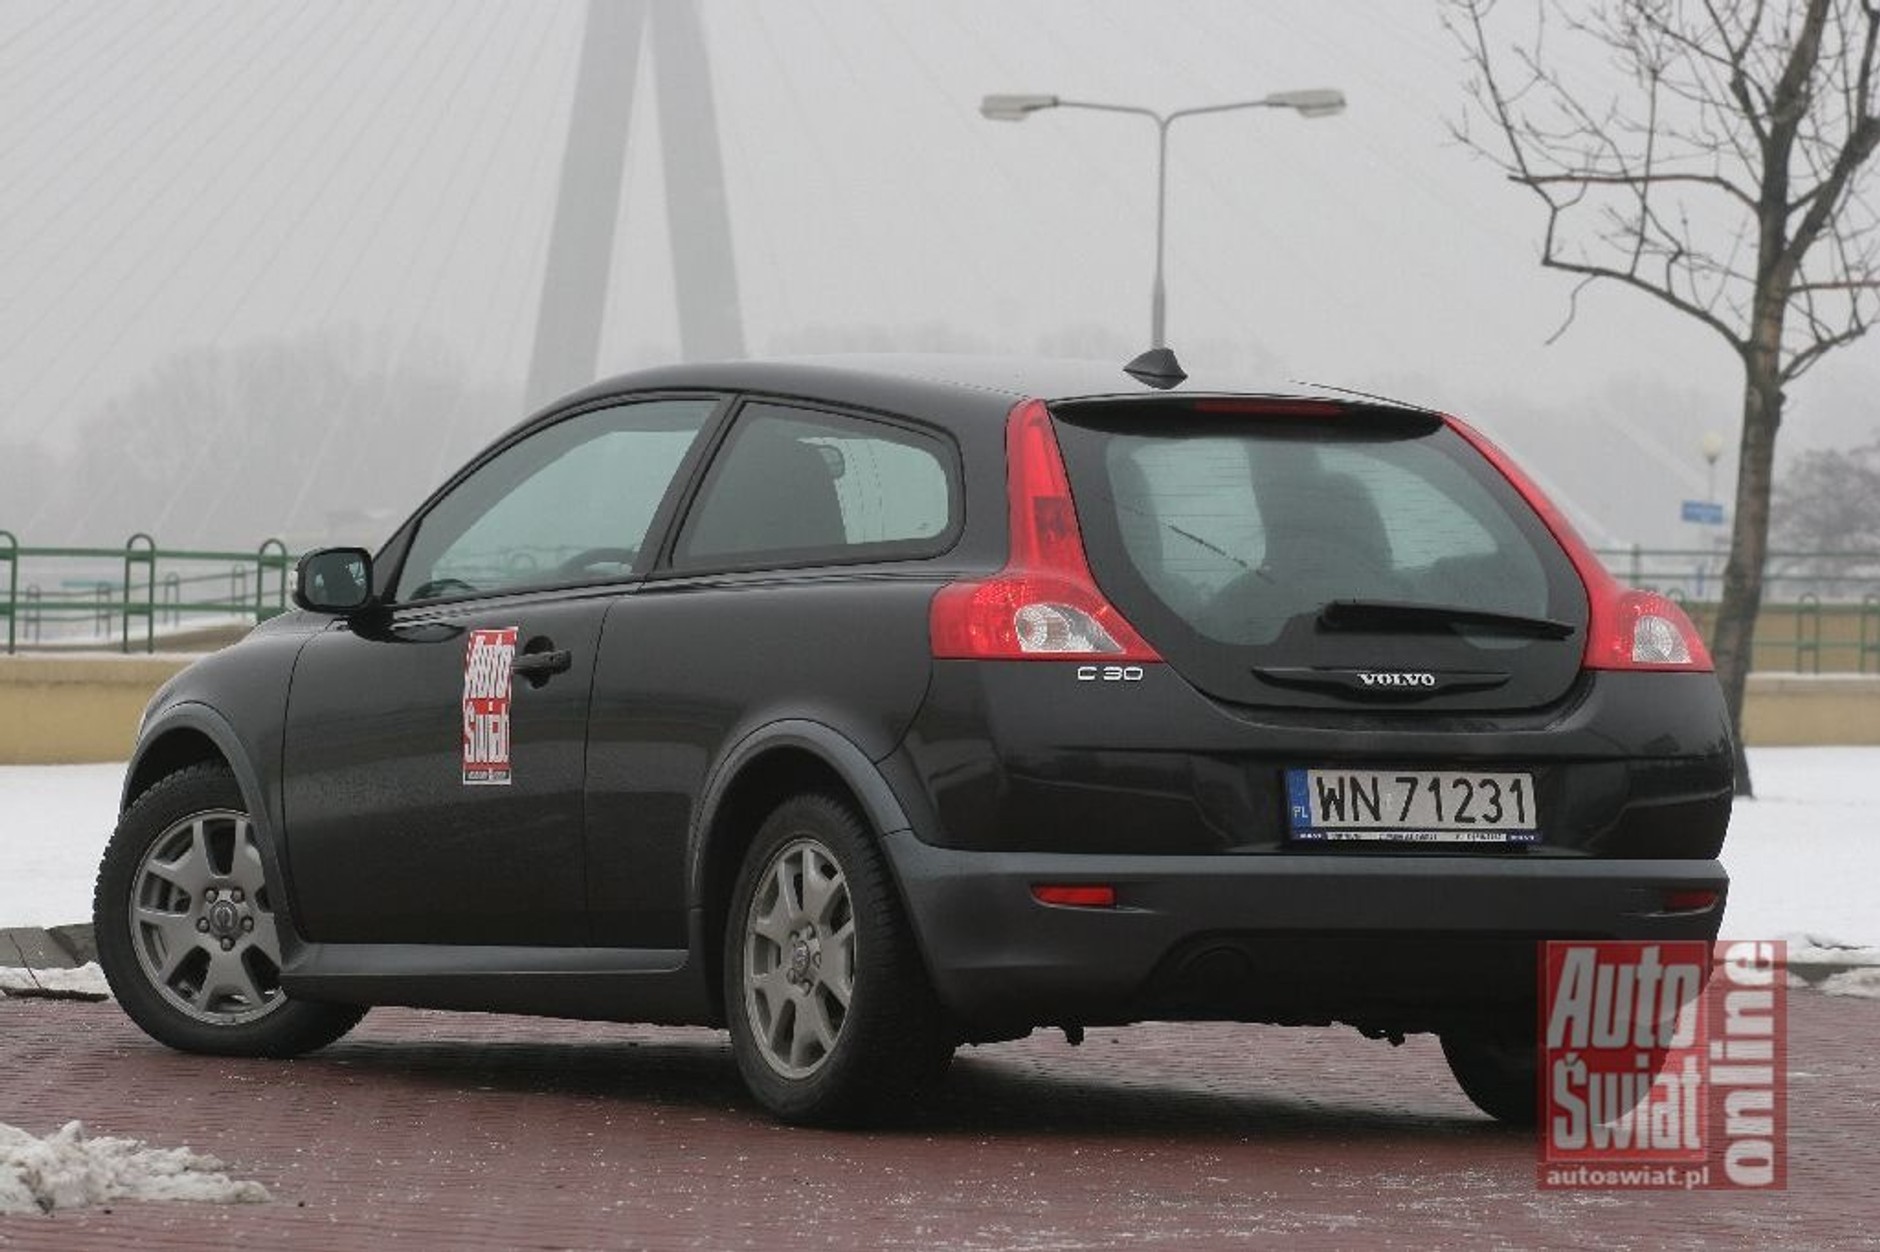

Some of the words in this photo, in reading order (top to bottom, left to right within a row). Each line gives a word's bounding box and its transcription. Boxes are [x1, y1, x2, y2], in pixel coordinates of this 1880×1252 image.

[1077, 666, 1098, 681] C
[1103, 666, 1144, 681] 30
[1356, 673, 1436, 686] VOLVO
[1316, 775, 1382, 822] WN
[1394, 776, 1526, 824] 71231
